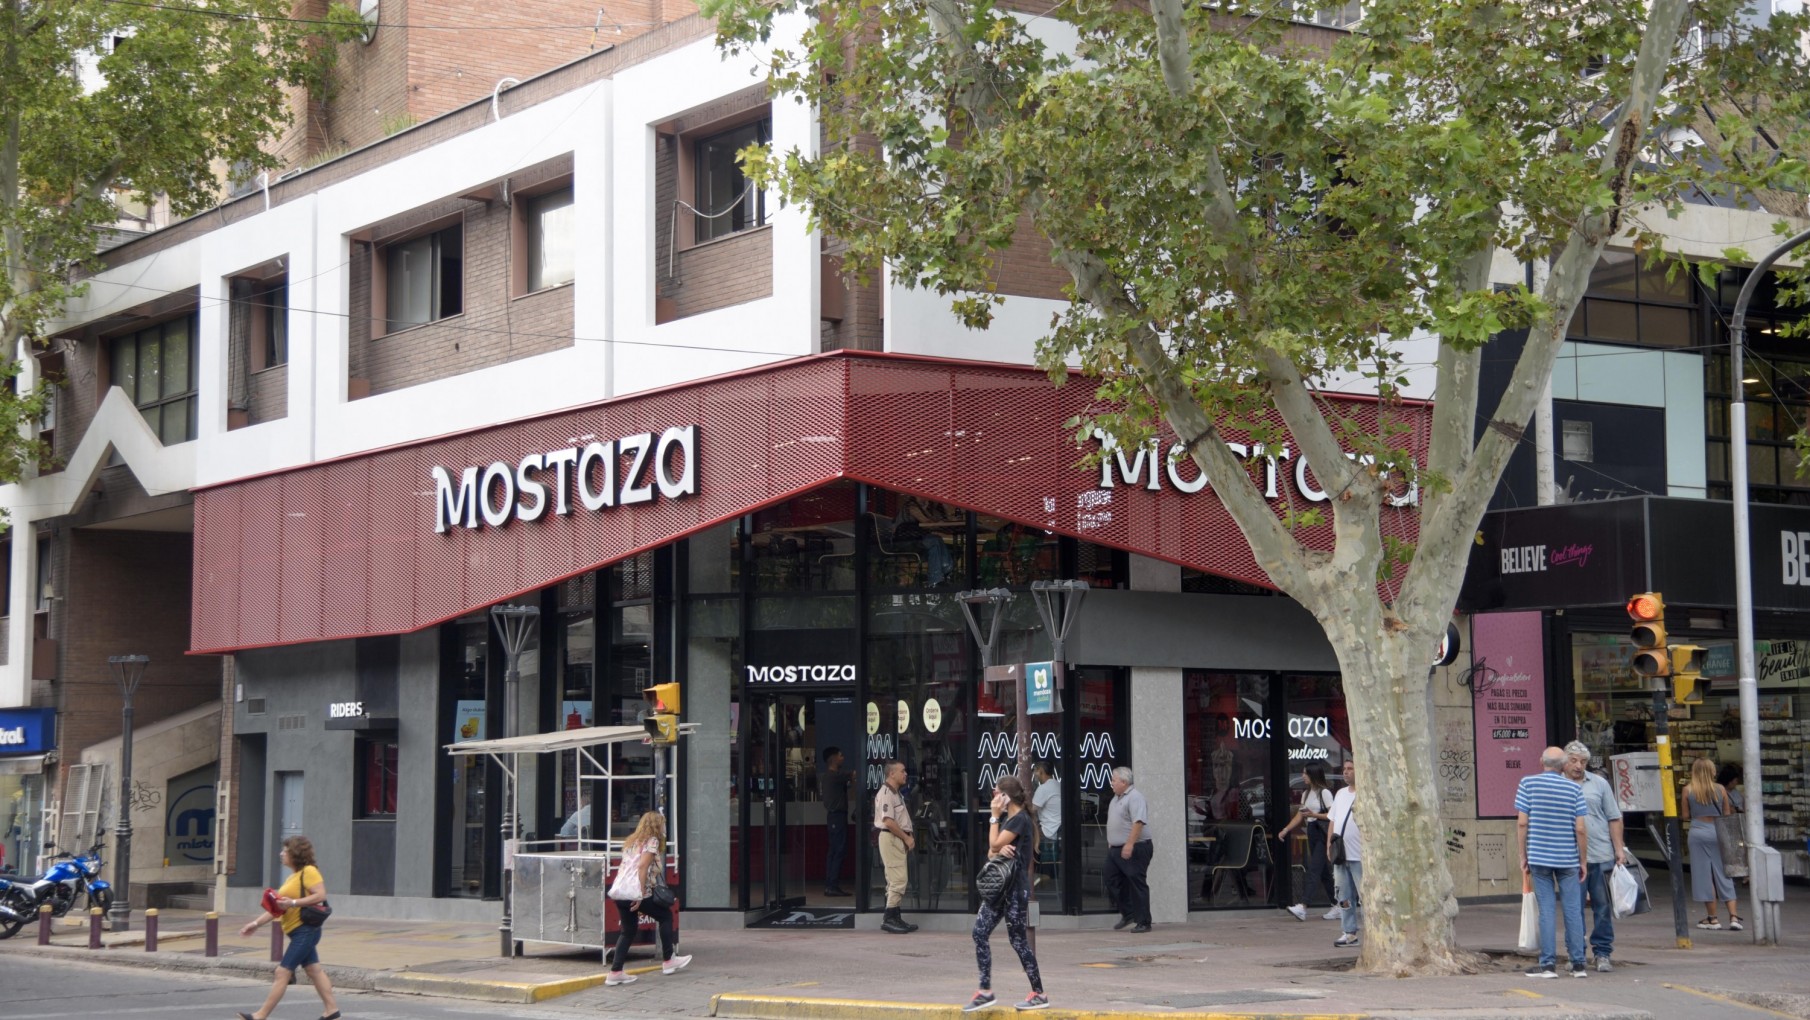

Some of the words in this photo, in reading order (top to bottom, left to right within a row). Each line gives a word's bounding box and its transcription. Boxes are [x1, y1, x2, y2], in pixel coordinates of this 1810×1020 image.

[1501, 545, 1547, 574] BELIEVE
[330, 701, 363, 717] RIDERS
[1287, 744, 1328, 760] endoza
